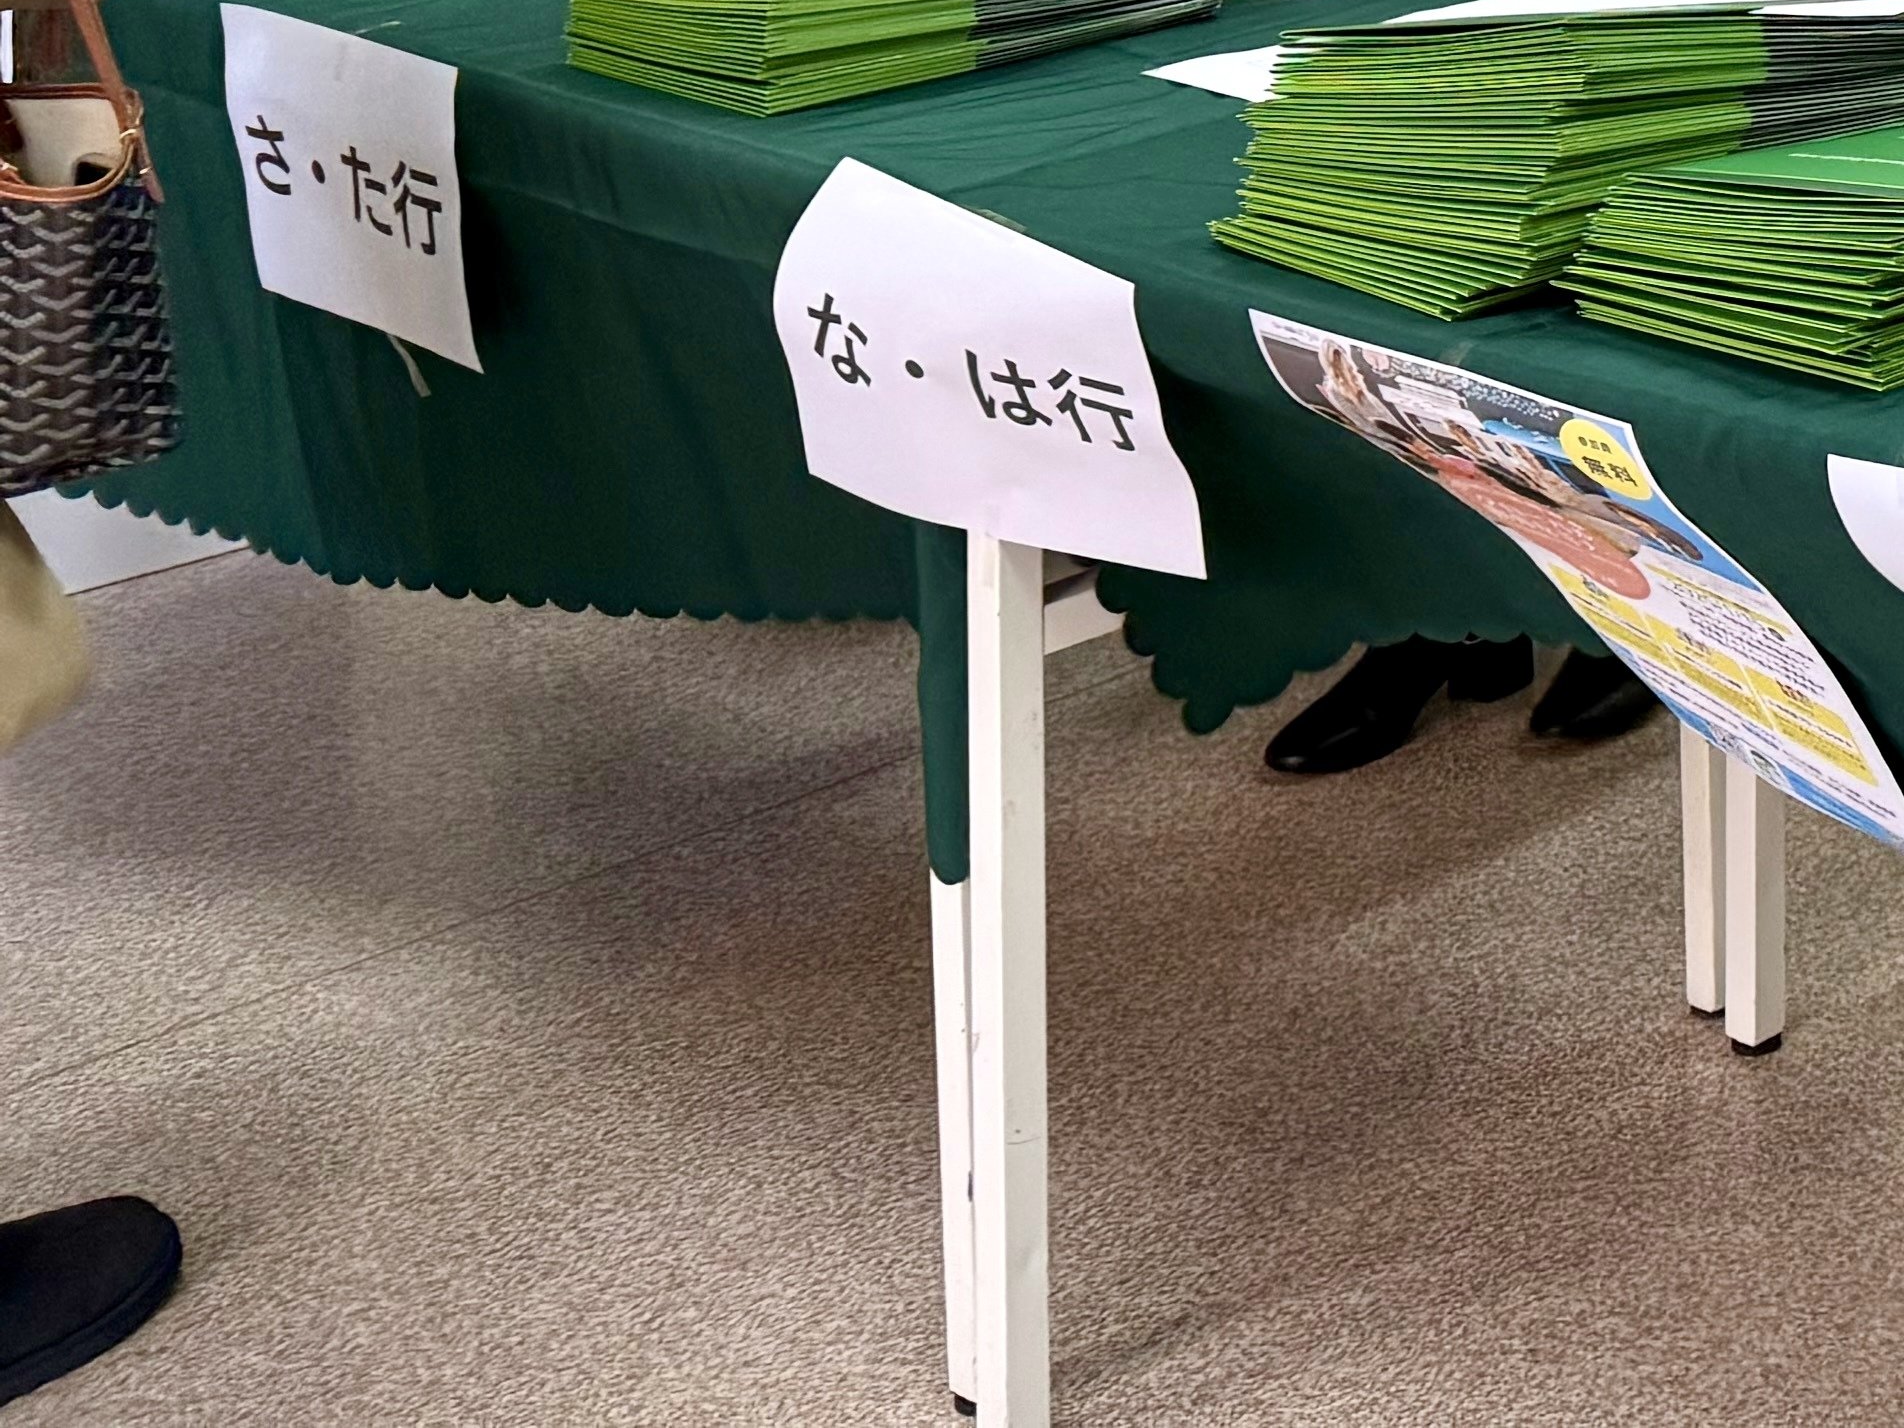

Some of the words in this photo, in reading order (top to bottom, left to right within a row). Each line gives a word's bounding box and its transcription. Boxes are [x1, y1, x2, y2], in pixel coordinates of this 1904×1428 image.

[244, 112, 443, 258] さ・た行
[806, 290, 1137, 455] な・は行
